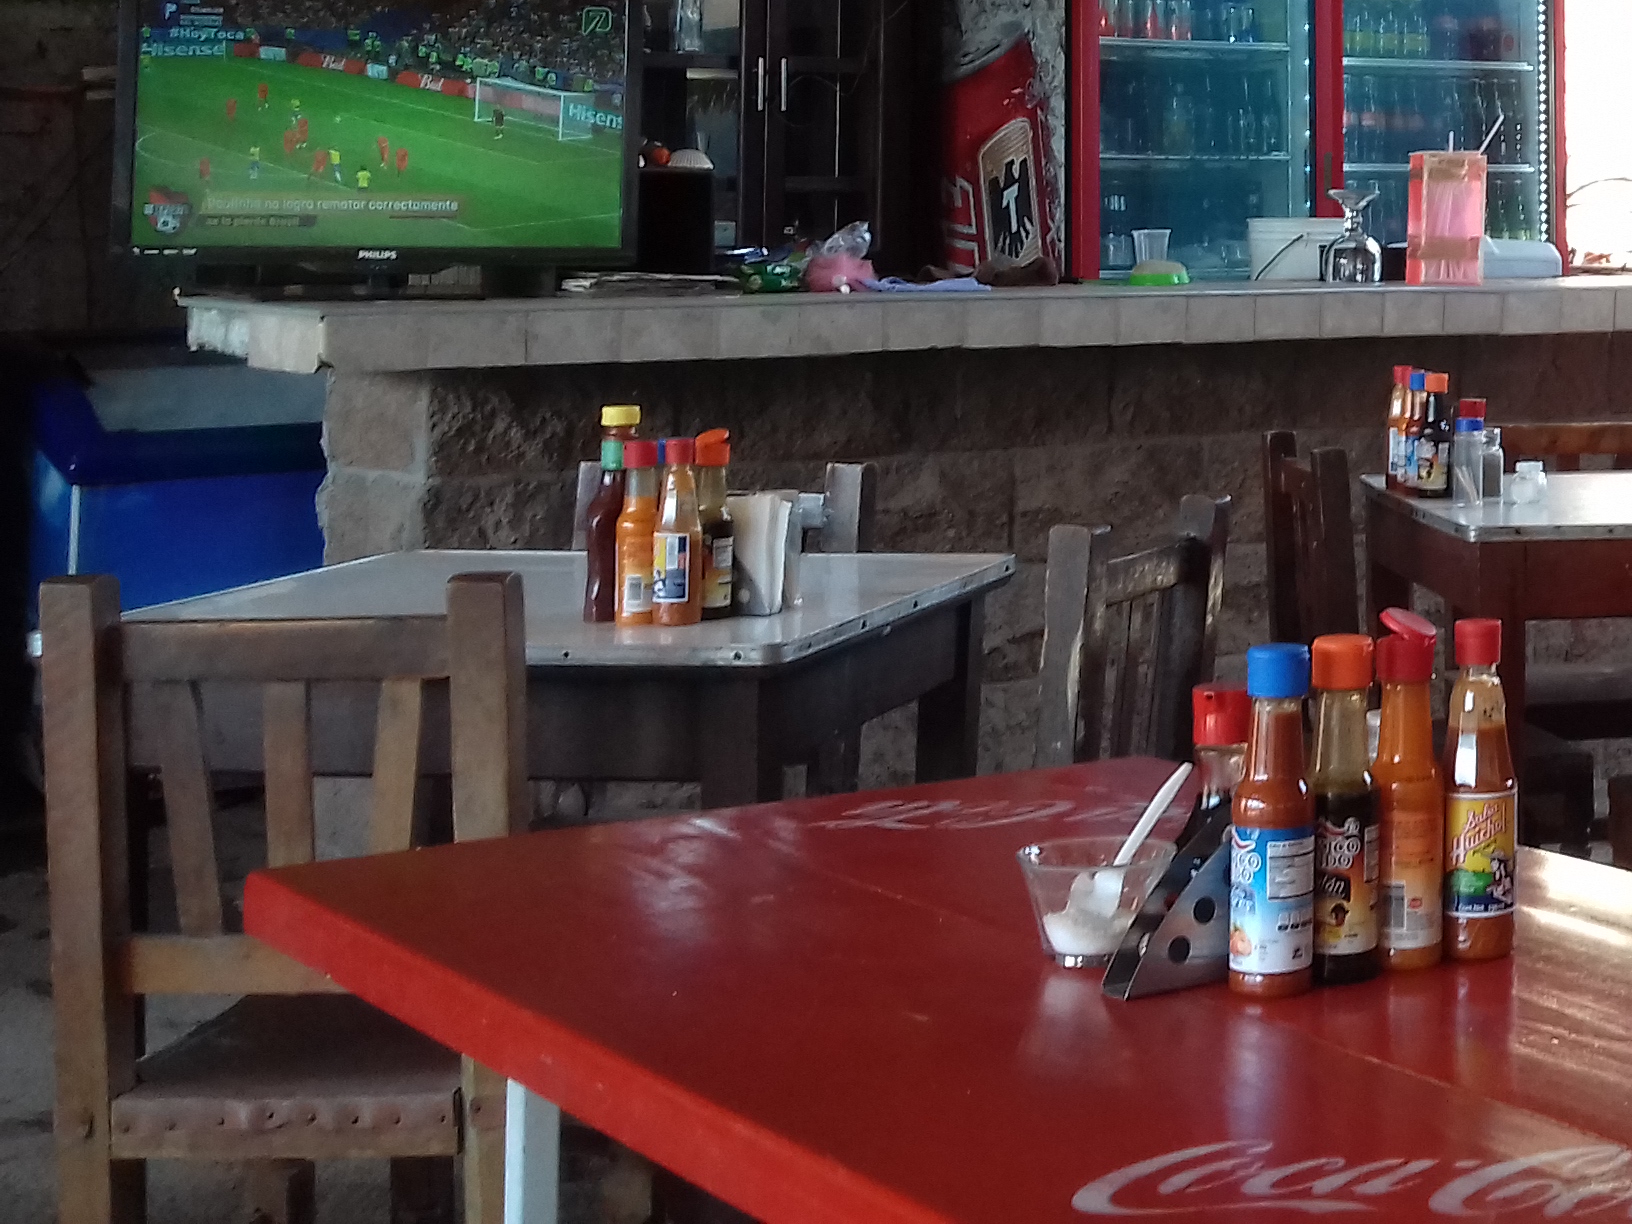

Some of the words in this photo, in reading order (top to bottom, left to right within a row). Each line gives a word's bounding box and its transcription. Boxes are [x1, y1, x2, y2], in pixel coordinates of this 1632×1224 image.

[169, 27, 245, 42] #HoyToca
[141, 42, 225, 56] Hisense
[368, 199, 459, 212] correctamente
[357, 249, 398, 260] PHILIPS
[1451, 801, 1507, 866] Huichol
